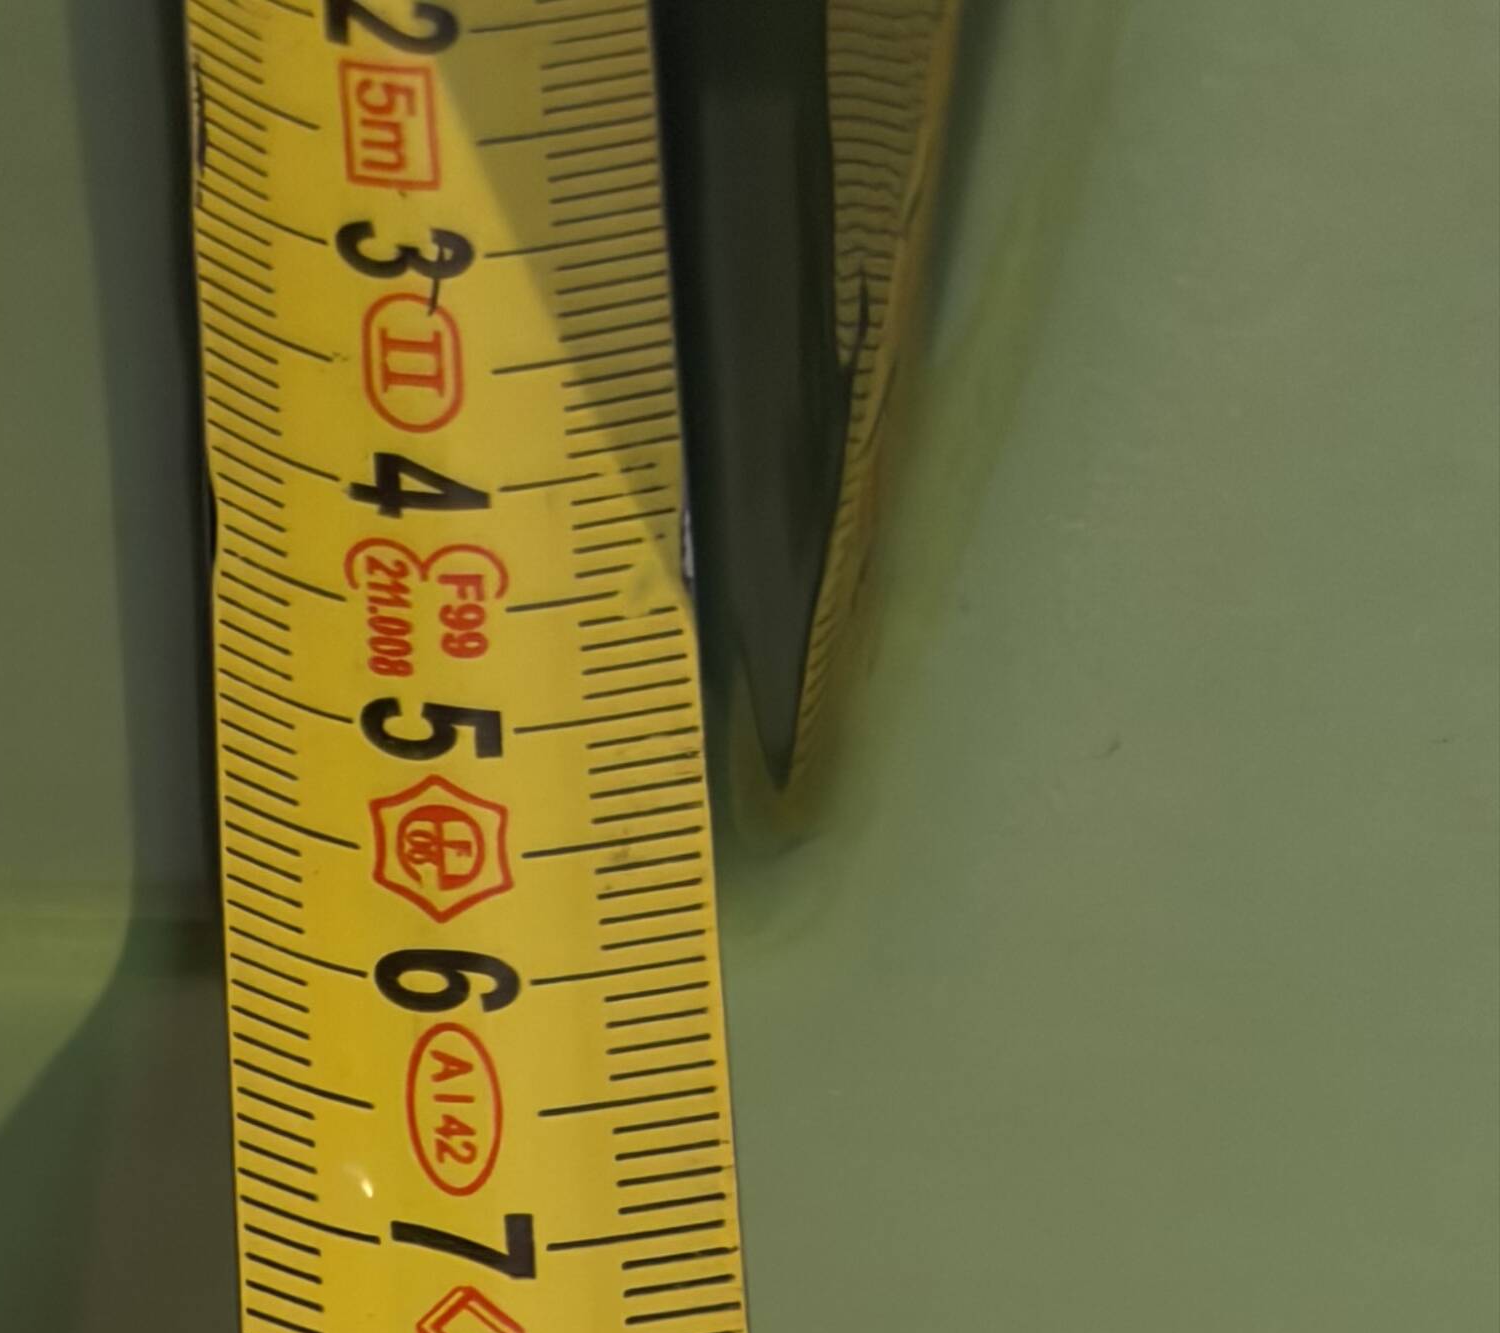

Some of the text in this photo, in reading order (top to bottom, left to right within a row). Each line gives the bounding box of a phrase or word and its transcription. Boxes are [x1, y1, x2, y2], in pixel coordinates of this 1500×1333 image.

[323, 0, 462, 54] 2
[355, 78, 417, 173] 5m
[334, 221, 475, 279] 3
[348, 452, 491, 518] 4
[365, 555, 414, 678] 211.008
[437, 573, 490, 660] F99
[360, 697, 503, 761] 5
[374, 949, 521, 1013] 6
[390, 1213, 536, 1280] 7
